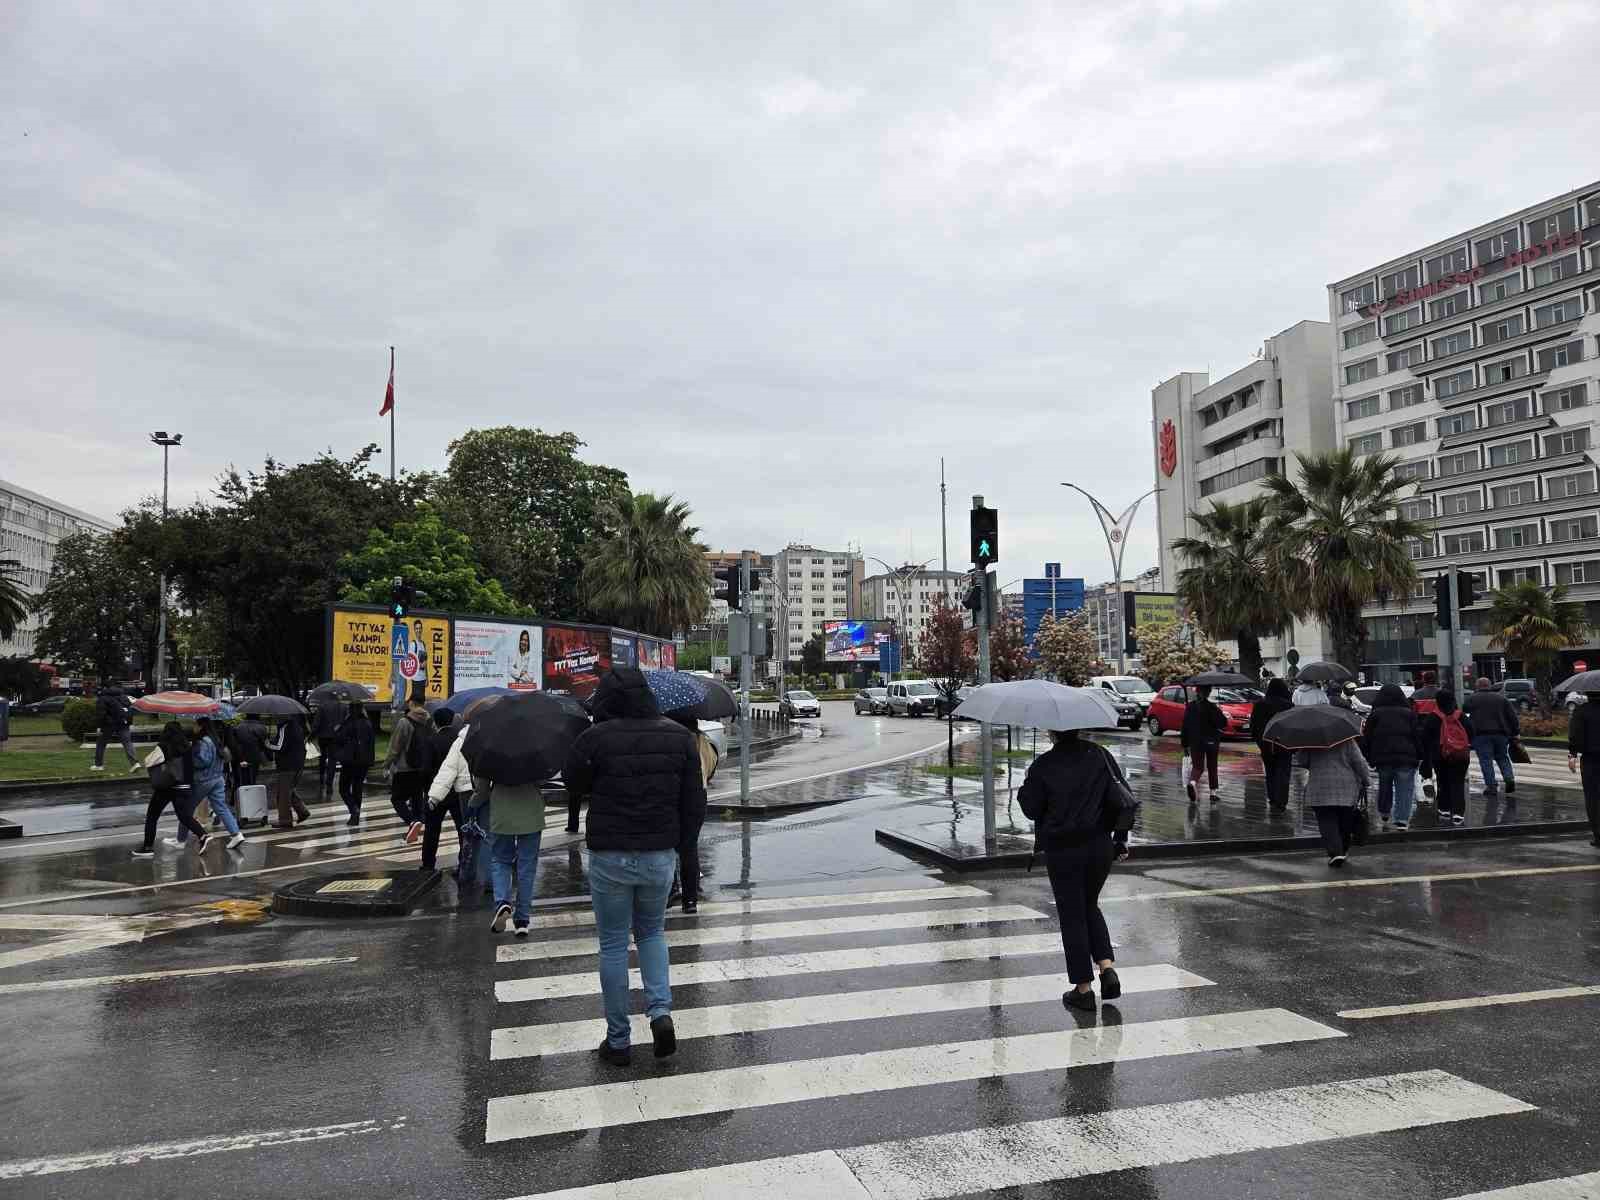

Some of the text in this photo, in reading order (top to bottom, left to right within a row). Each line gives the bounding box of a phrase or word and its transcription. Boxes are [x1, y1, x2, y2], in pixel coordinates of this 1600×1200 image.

[1503, 231, 1584, 271] HOTEL
[348, 622, 385, 633] TYT YAZ
[353, 633, 381, 643] KAMPI
[404, 659, 416, 668] 120
